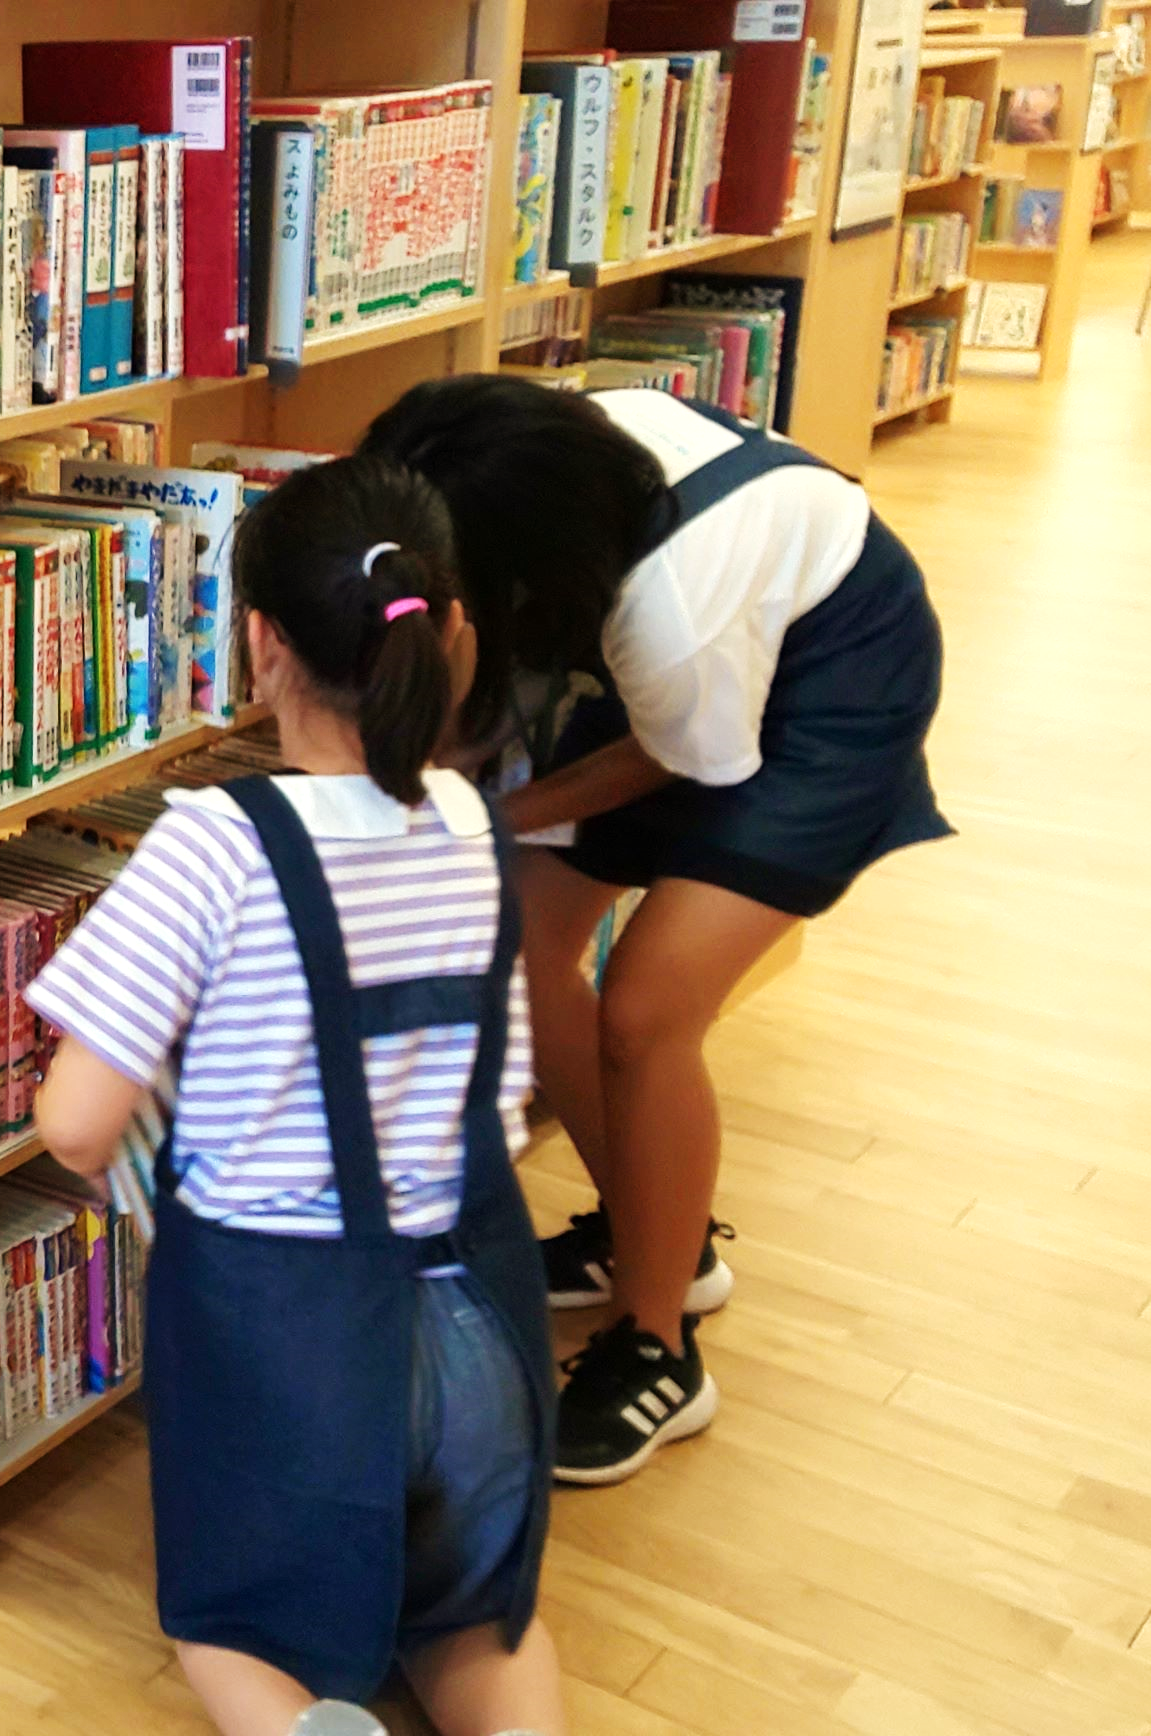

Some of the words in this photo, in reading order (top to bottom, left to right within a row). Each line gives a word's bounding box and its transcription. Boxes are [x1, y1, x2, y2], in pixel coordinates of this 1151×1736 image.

[286, 138, 301, 154] ス
[579, 73, 602, 247] ウルフ・スタルク
[281, 165, 301, 241] よみもの
